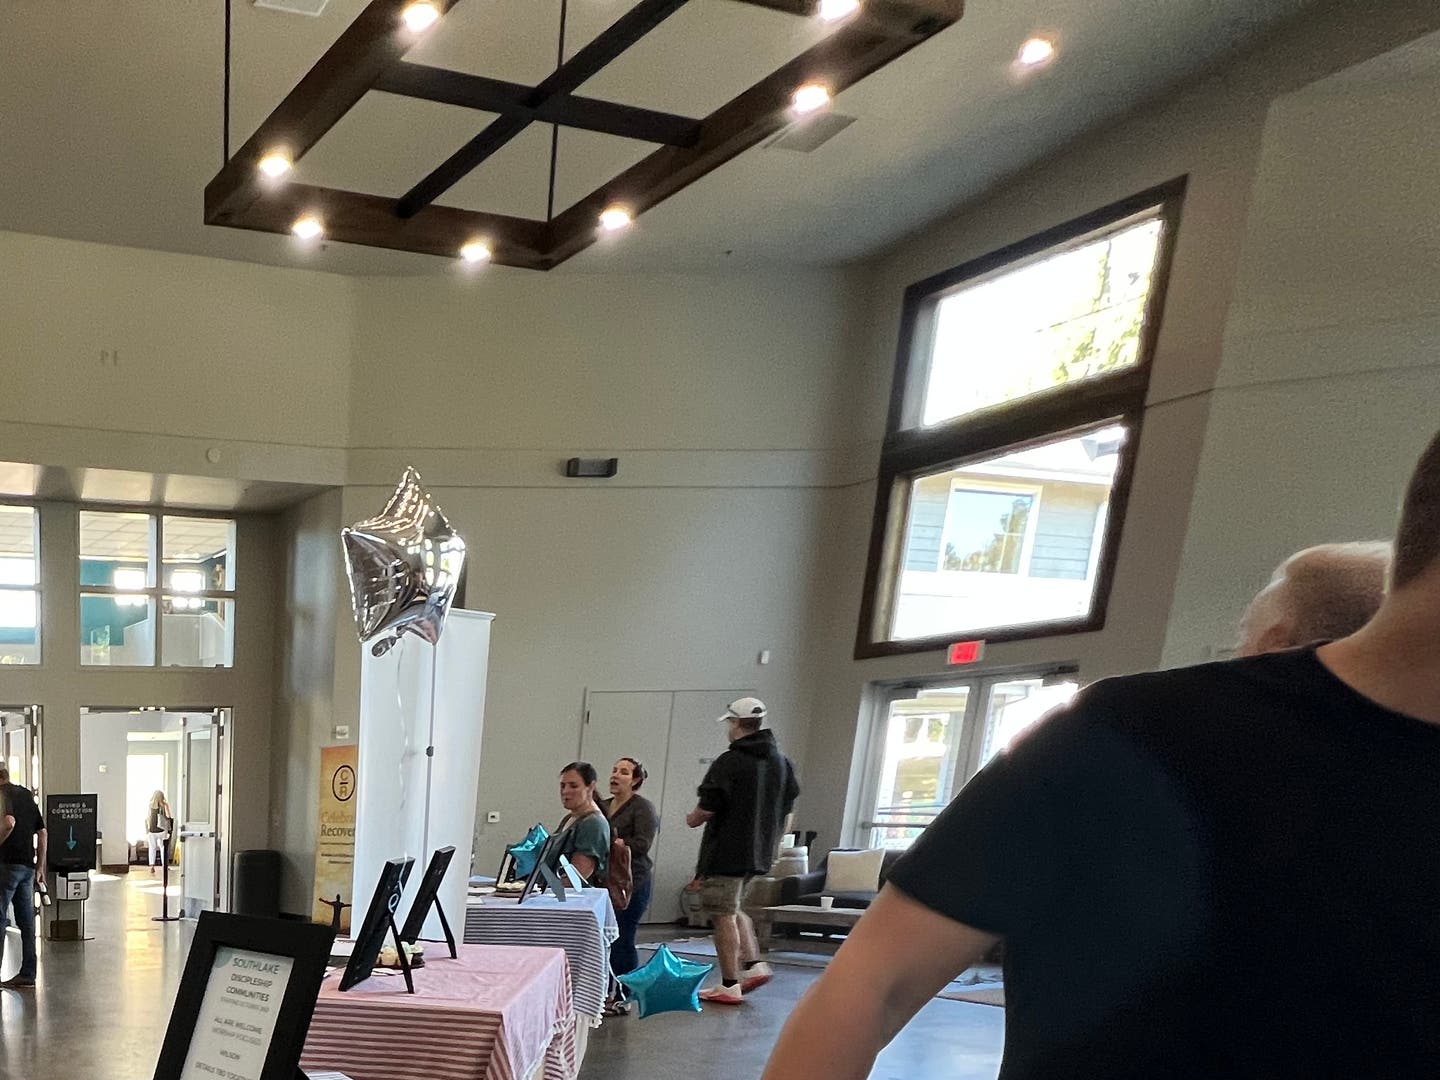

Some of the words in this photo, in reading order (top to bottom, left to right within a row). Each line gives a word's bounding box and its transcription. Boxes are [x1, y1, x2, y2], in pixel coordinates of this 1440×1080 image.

[232, 957, 280, 975] SOUTHLAKE
[230, 973, 273, 988] DISCIPLESHIP
[226, 986, 270, 1002] COMMUNITIES
